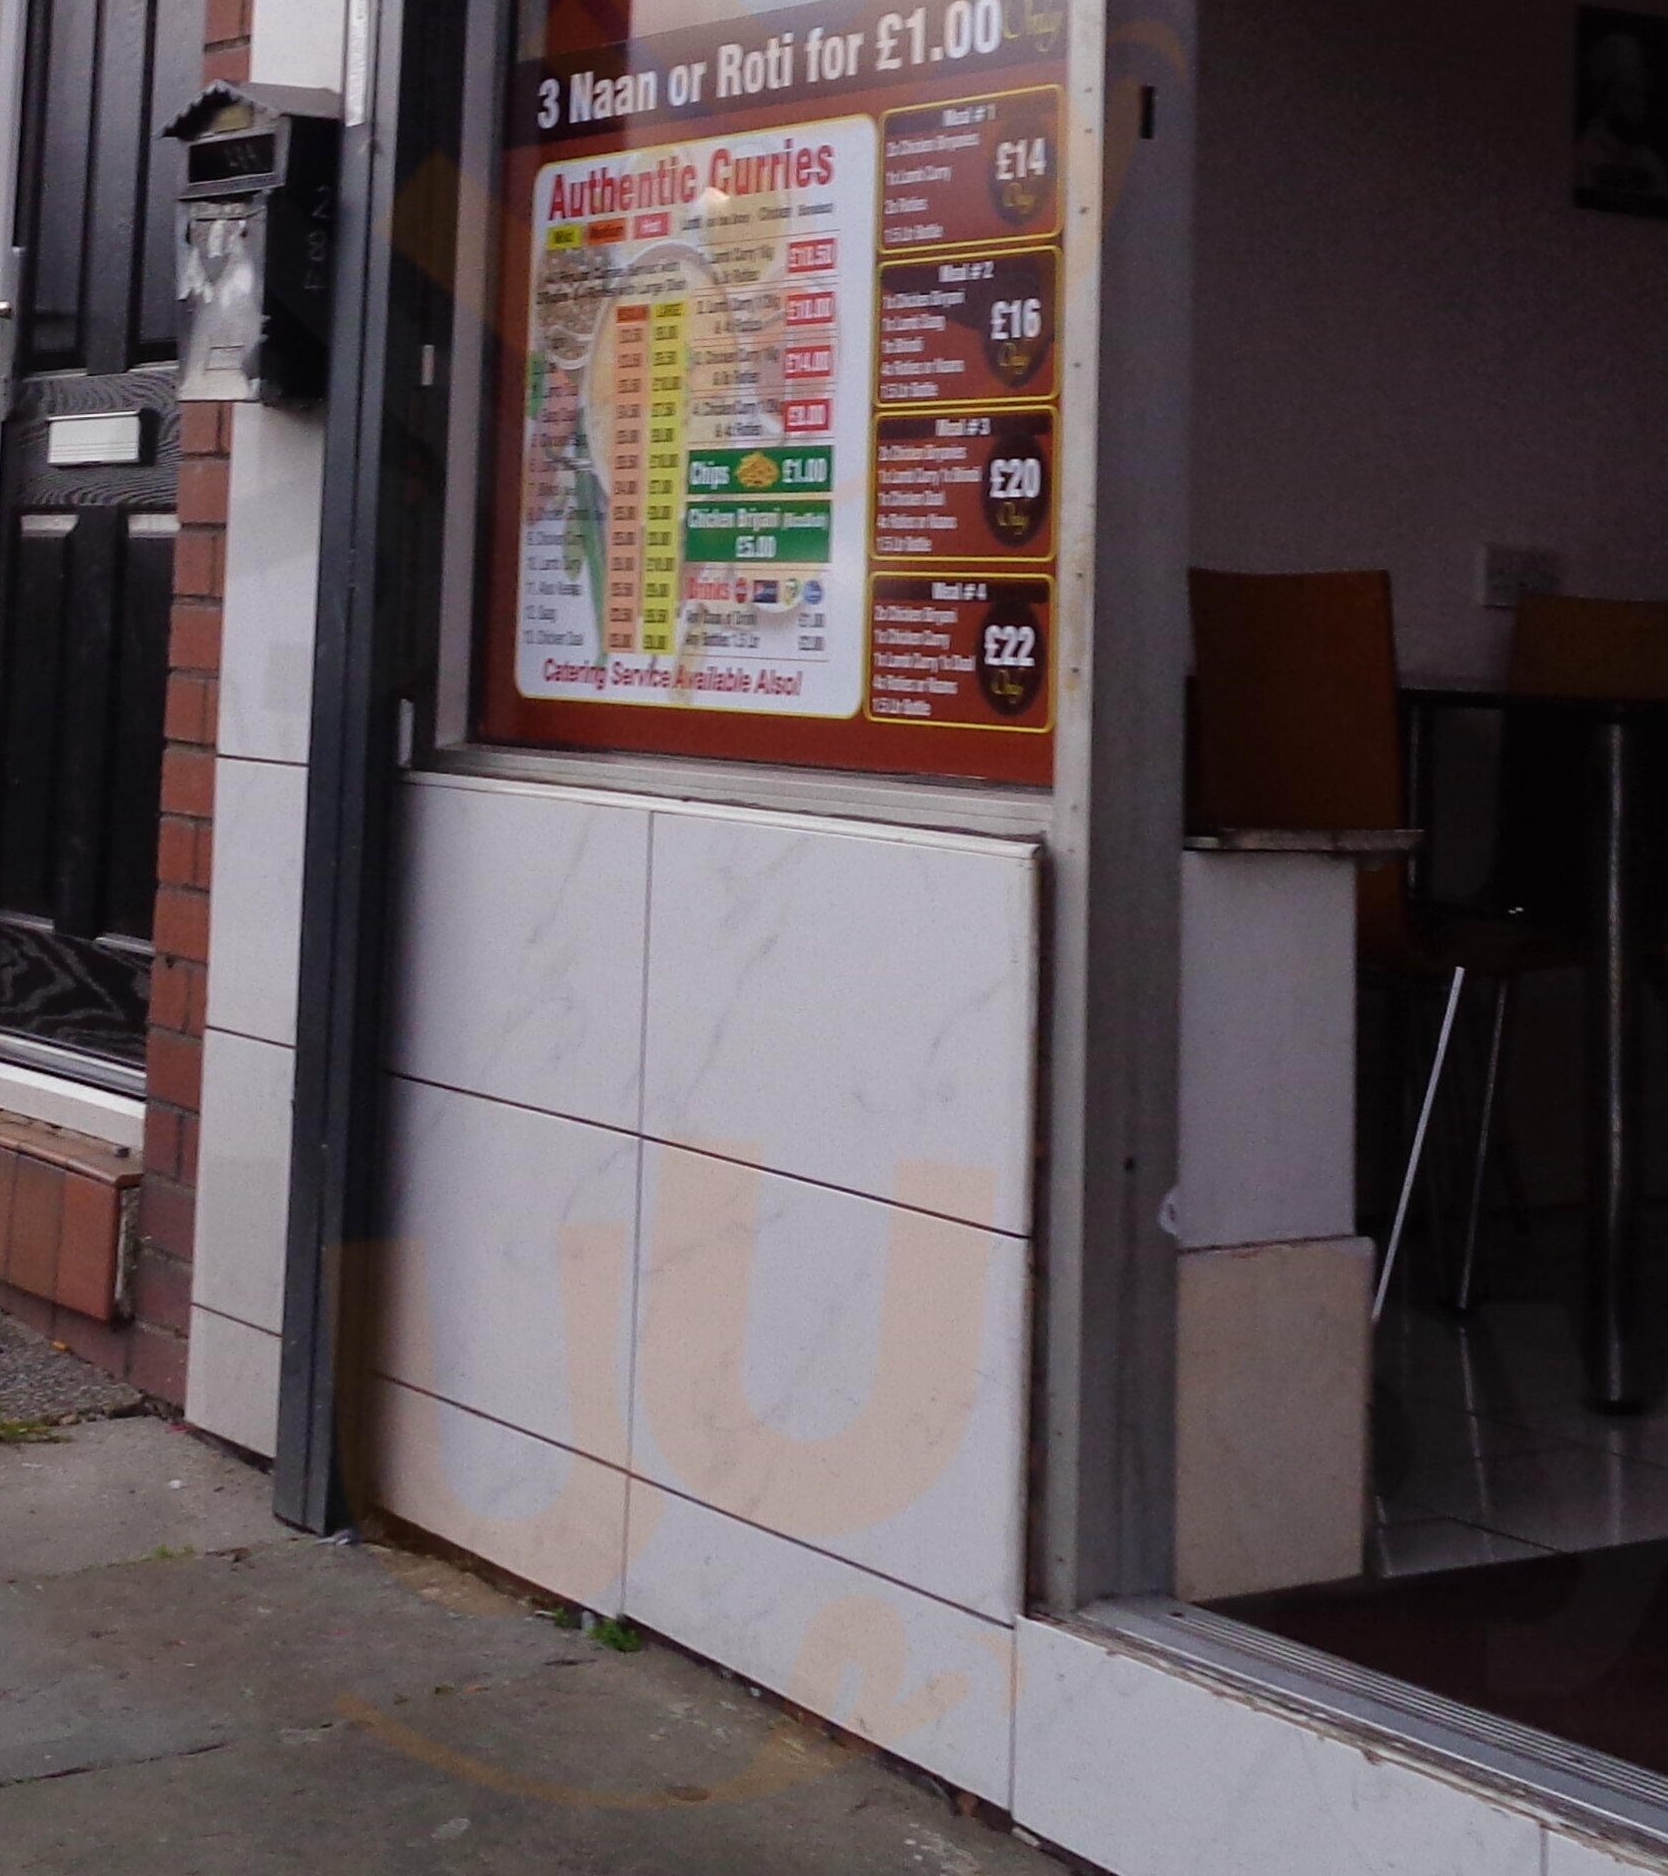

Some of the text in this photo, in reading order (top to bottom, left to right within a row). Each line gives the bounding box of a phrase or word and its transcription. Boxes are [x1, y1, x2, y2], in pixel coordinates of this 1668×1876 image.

[537, 79, 560, 129] 3
[570, 69, 657, 124] Naan
[668, 62, 706, 106] or
[716, 33, 793, 99] Roti
[806, 27, 864, 82] for
[549, 138, 833, 220] Authentic Curries
[996, 137, 1047, 181] £14
[990, 297, 1042, 341] £16
[690, 458, 827, 489] Chips £1.00
[990, 458, 1041, 498] £20
[687, 508, 735, 528] Chicken
[735, 535, 777, 558] £5.00
[984, 625, 1035, 666] £22
[543, 658, 606, 690] Catering
[613, 661, 670, 688] Service
[674, 665, 750, 694] Available
